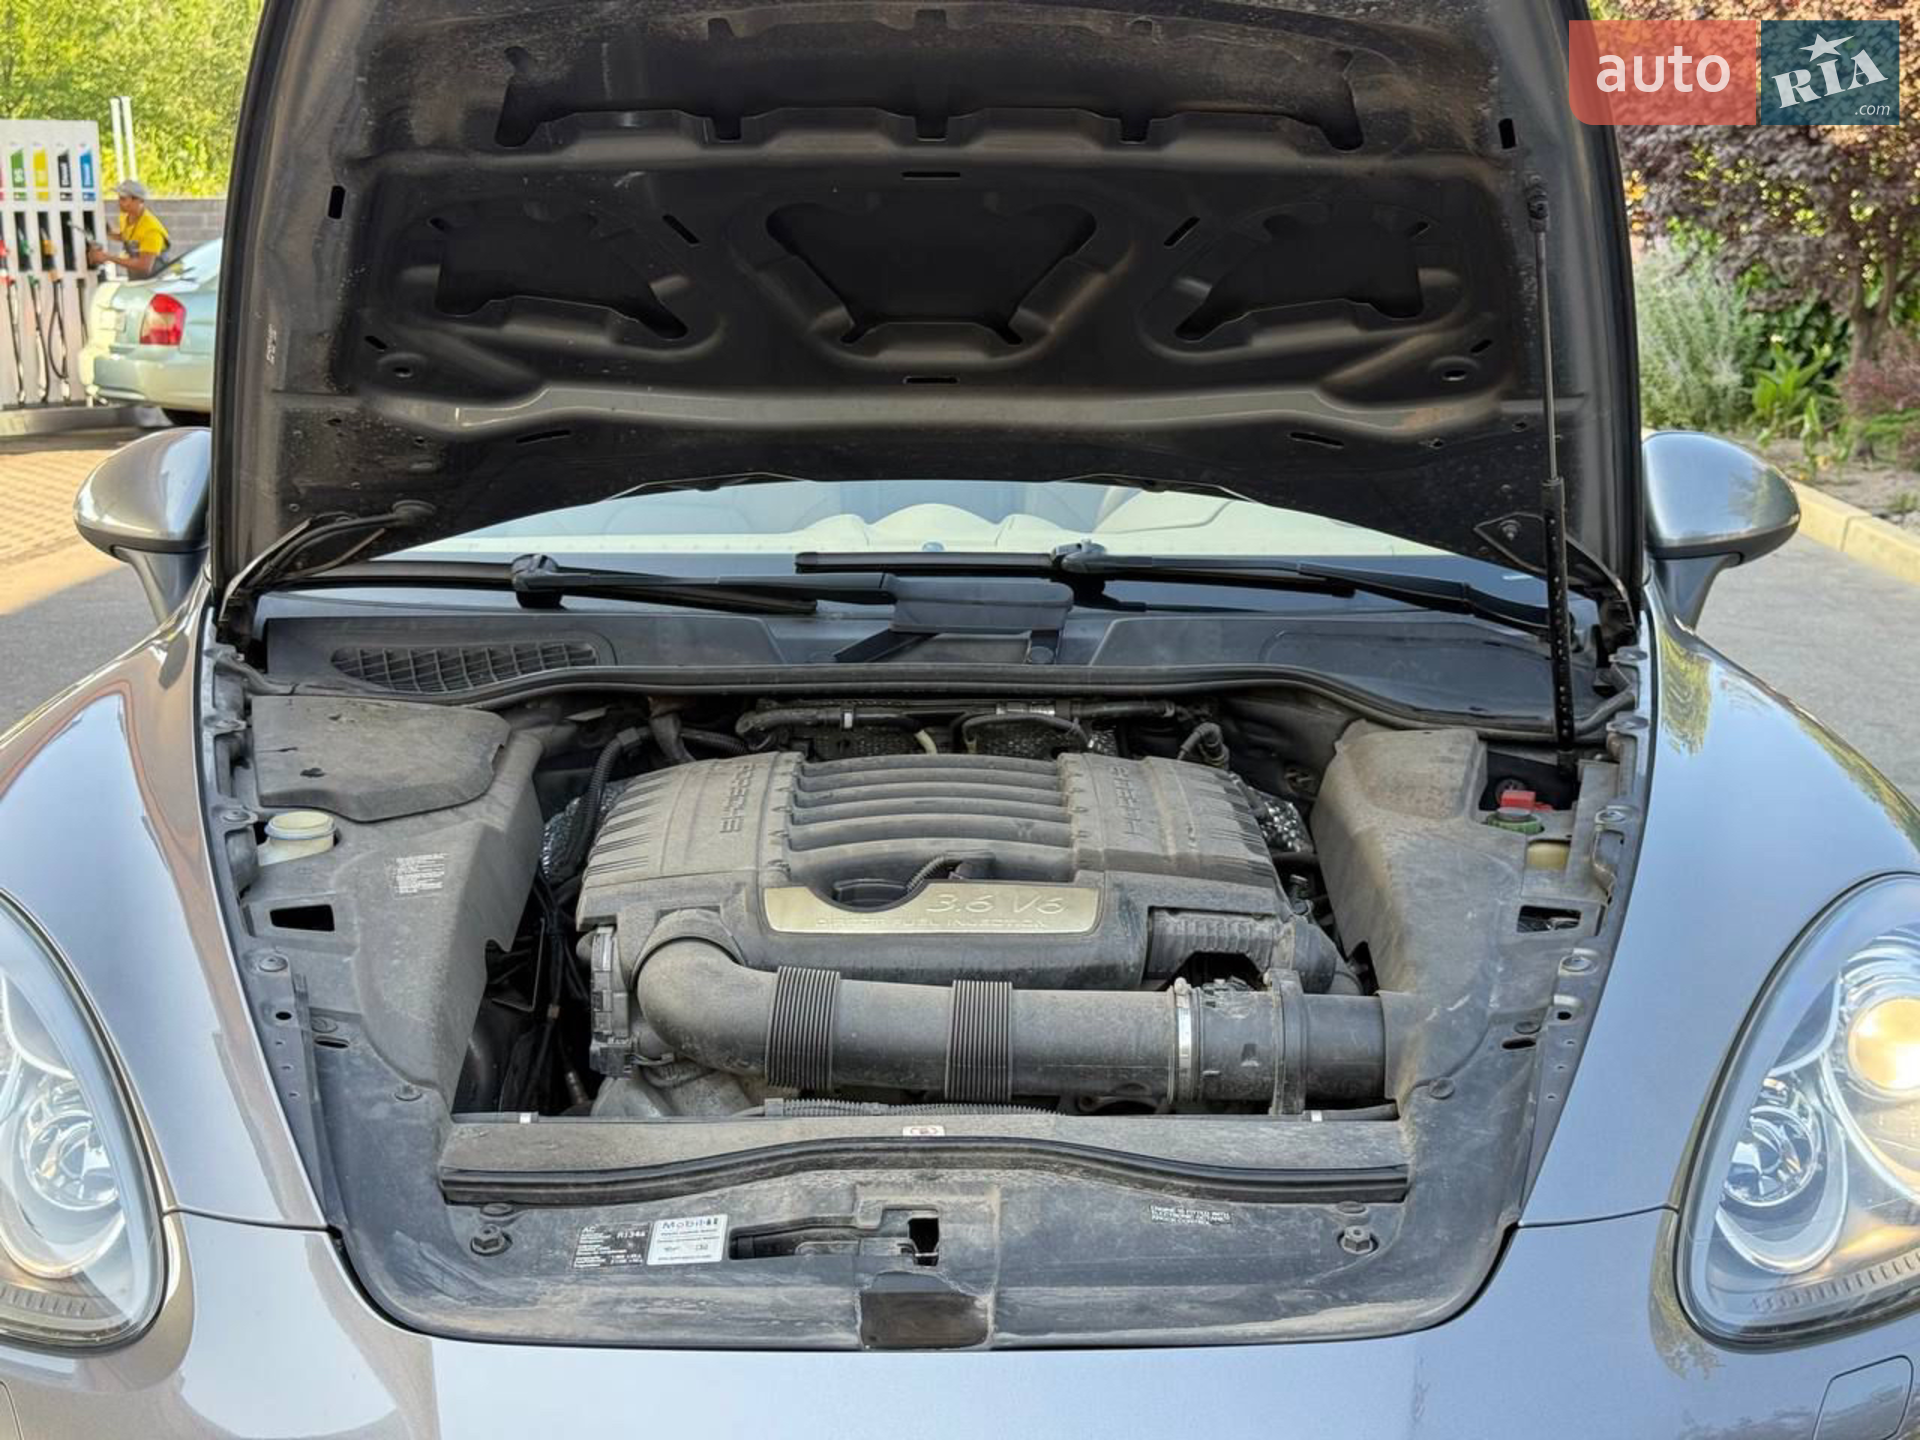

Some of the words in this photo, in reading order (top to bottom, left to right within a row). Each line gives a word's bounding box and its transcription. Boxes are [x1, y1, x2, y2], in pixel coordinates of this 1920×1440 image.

[926, 893, 994, 913] 3.6
[1012, 895, 1067, 915] V6
[894, 918, 940, 927] FUEL
[947, 918, 1048, 928] INJECTION
[662, 1218, 703, 1230] Mobil
